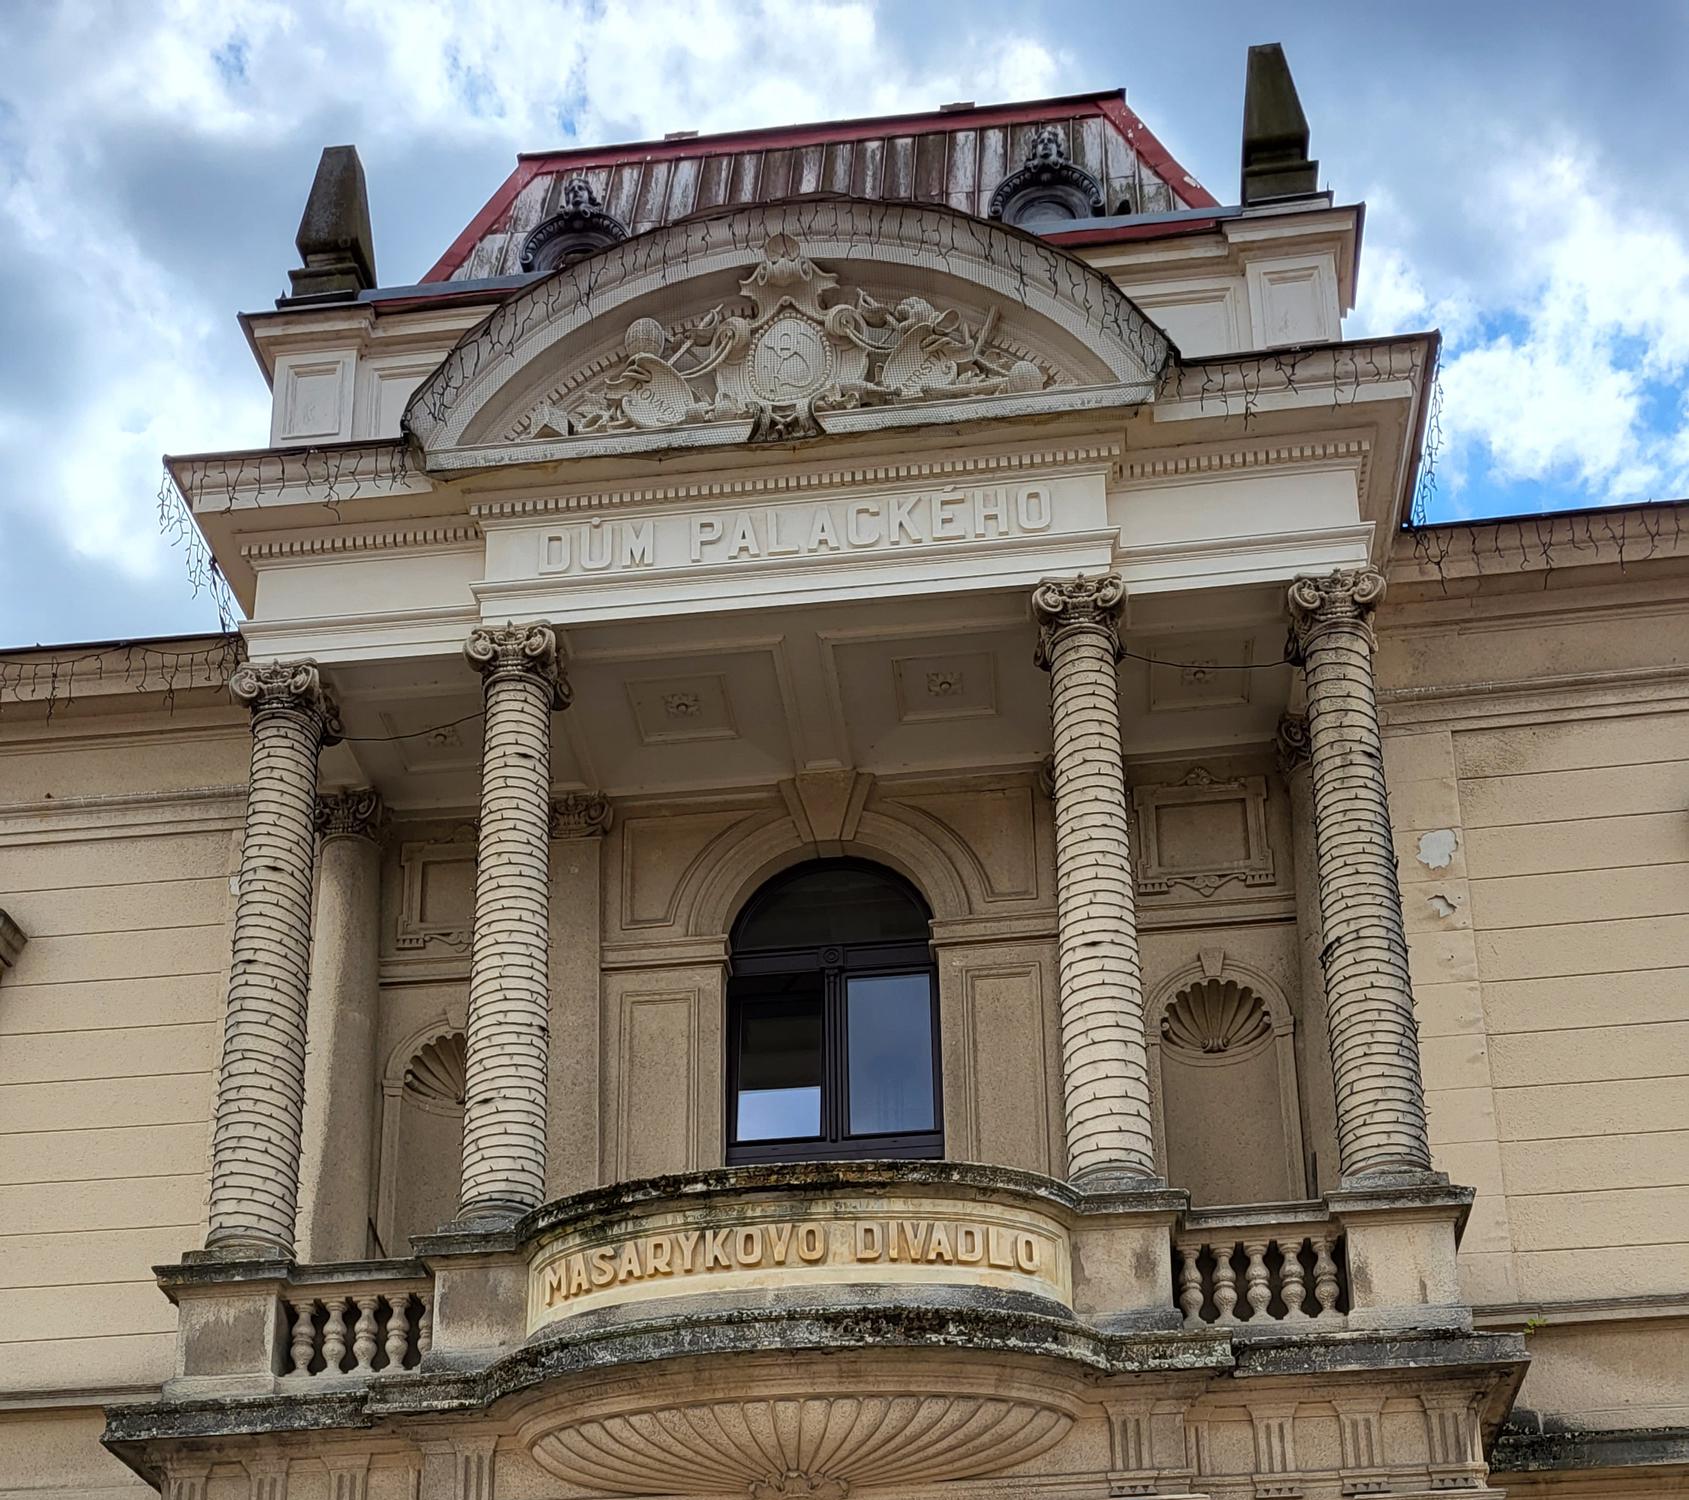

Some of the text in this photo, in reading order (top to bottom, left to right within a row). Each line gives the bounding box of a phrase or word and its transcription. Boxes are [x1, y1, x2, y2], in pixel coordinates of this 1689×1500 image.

[537, 486, 1053, 576] DŮM PALACKÉHO
[543, 1220, 1041, 1307] MASARYKOVO DIVADLO
